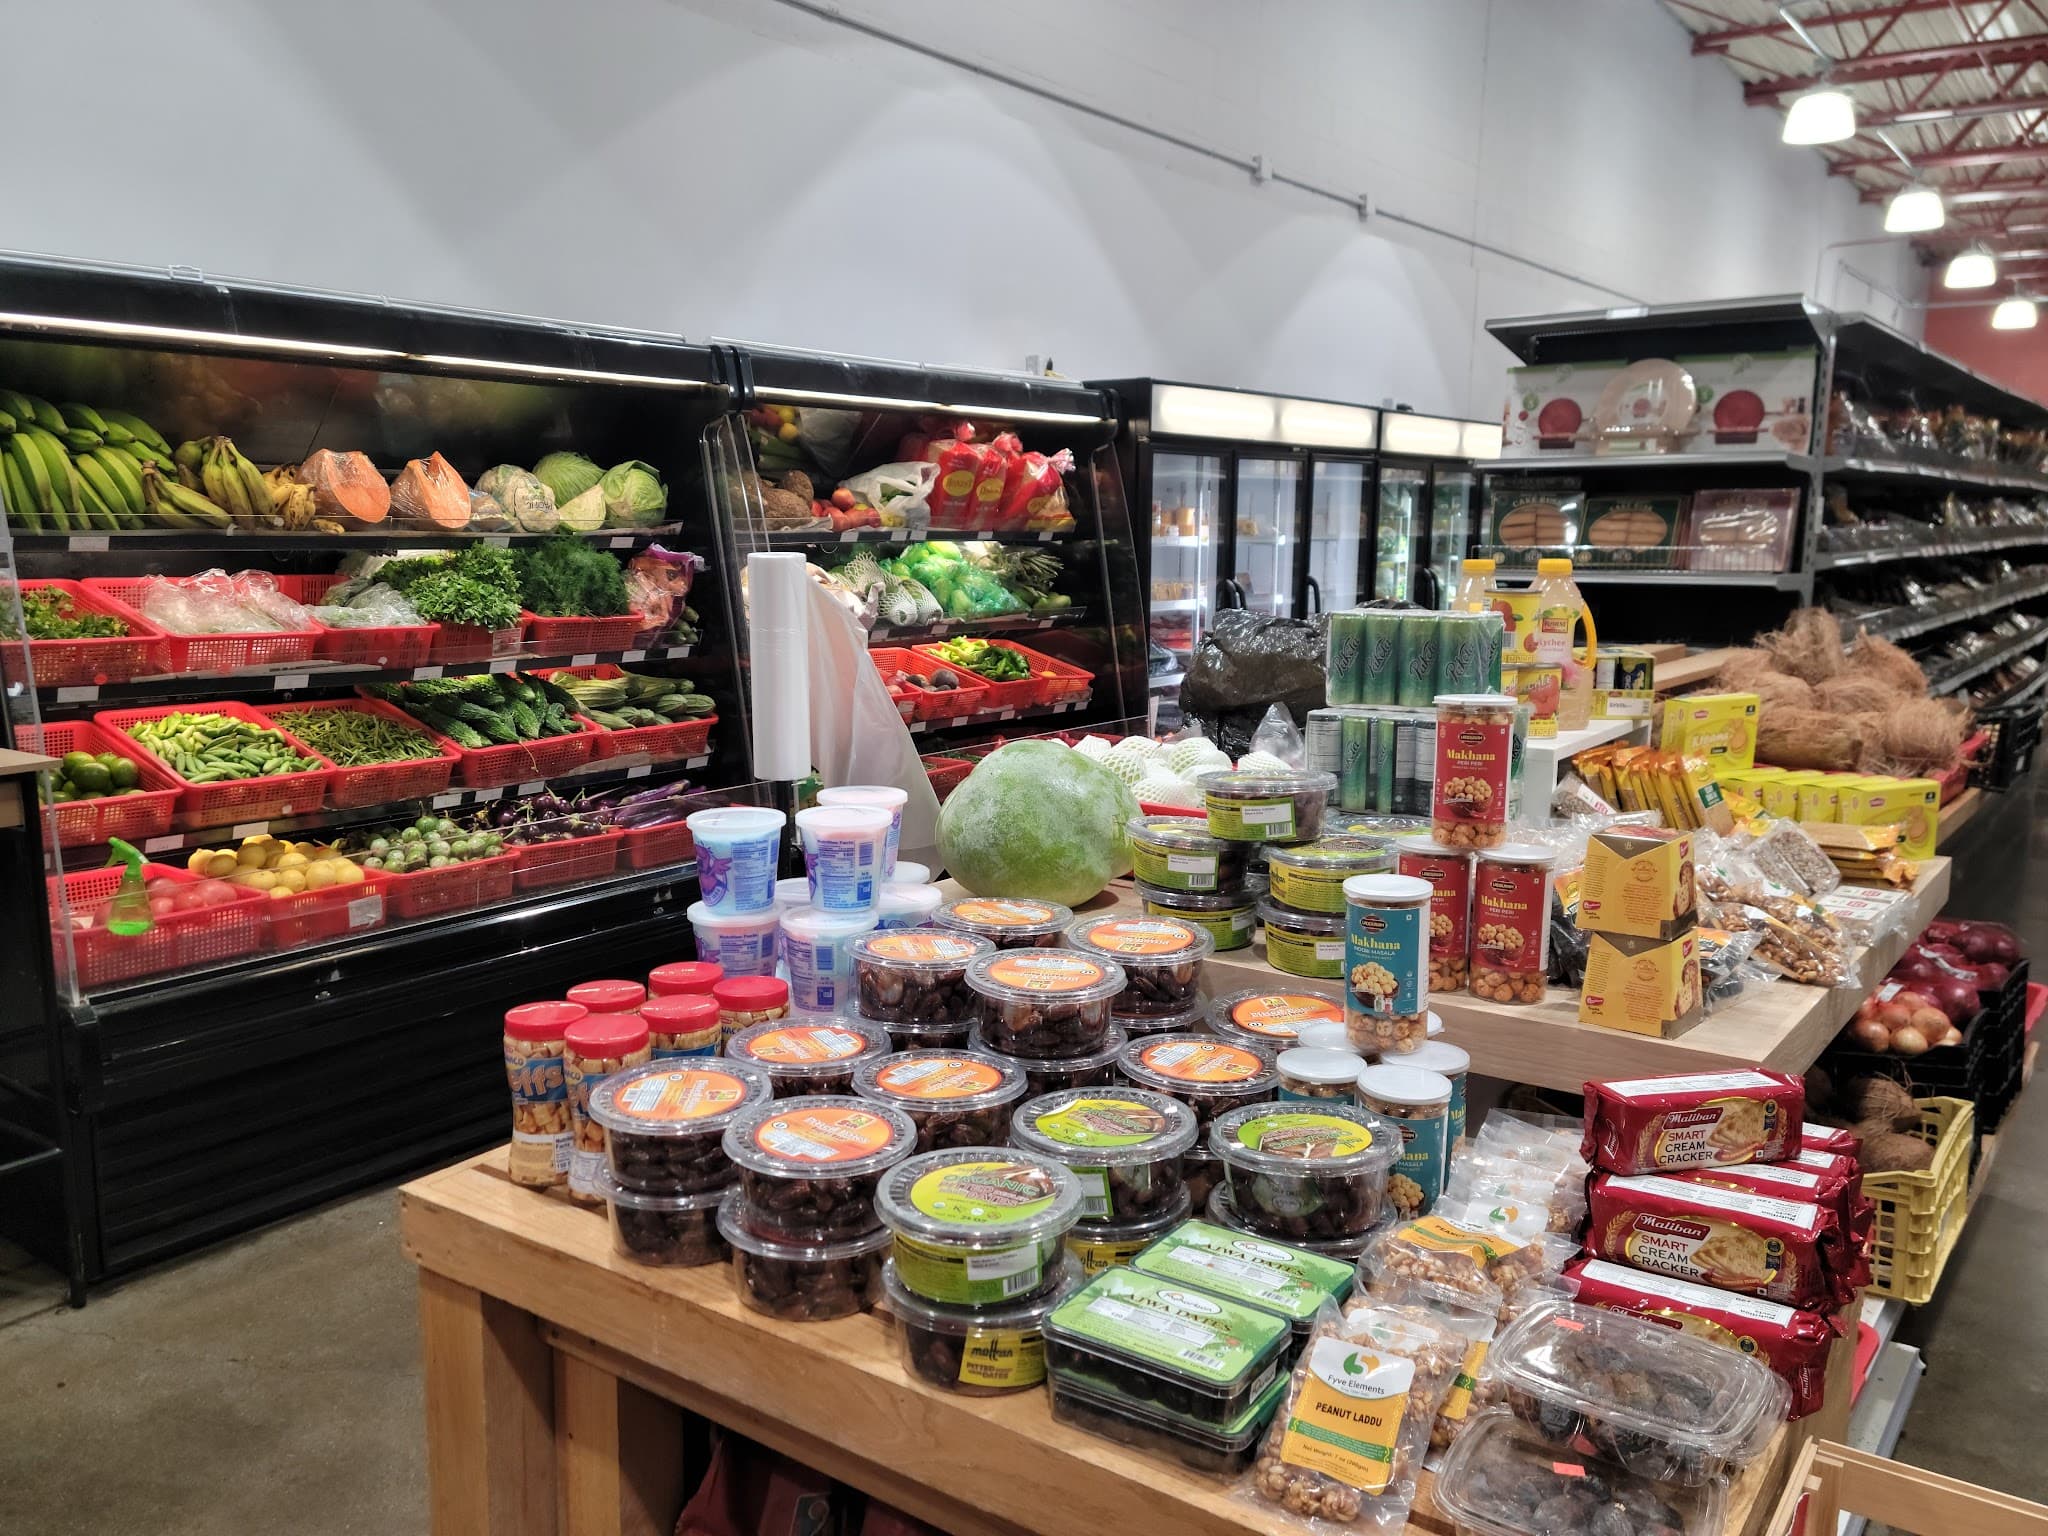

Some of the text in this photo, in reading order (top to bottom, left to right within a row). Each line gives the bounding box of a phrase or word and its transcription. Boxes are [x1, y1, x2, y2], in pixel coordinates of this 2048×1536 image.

[1446, 749, 1496, 761] Makhana
[1481, 895, 1528, 910] Makhana
[1351, 934, 1401, 951] Makhana
[1668, 1112, 1717, 1125] Maliban
[1668, 1130, 1706, 1142] SMART
[1665, 1141, 1705, 1153] CREAM
[1659, 1151, 1713, 1164] CRACKER
[1640, 1215, 1703, 1236] Maliban
[1641, 1234, 1689, 1253] SMART
[1638, 1245, 1689, 1264] CREAM
[1631, 1254, 1700, 1278] CRACKER
[1176, 1308, 1233, 1332] DATES
[1327, 1374, 1385, 1395] Fyve Elements
[1315, 1401, 1383, 1427] PEANUT LADDU
